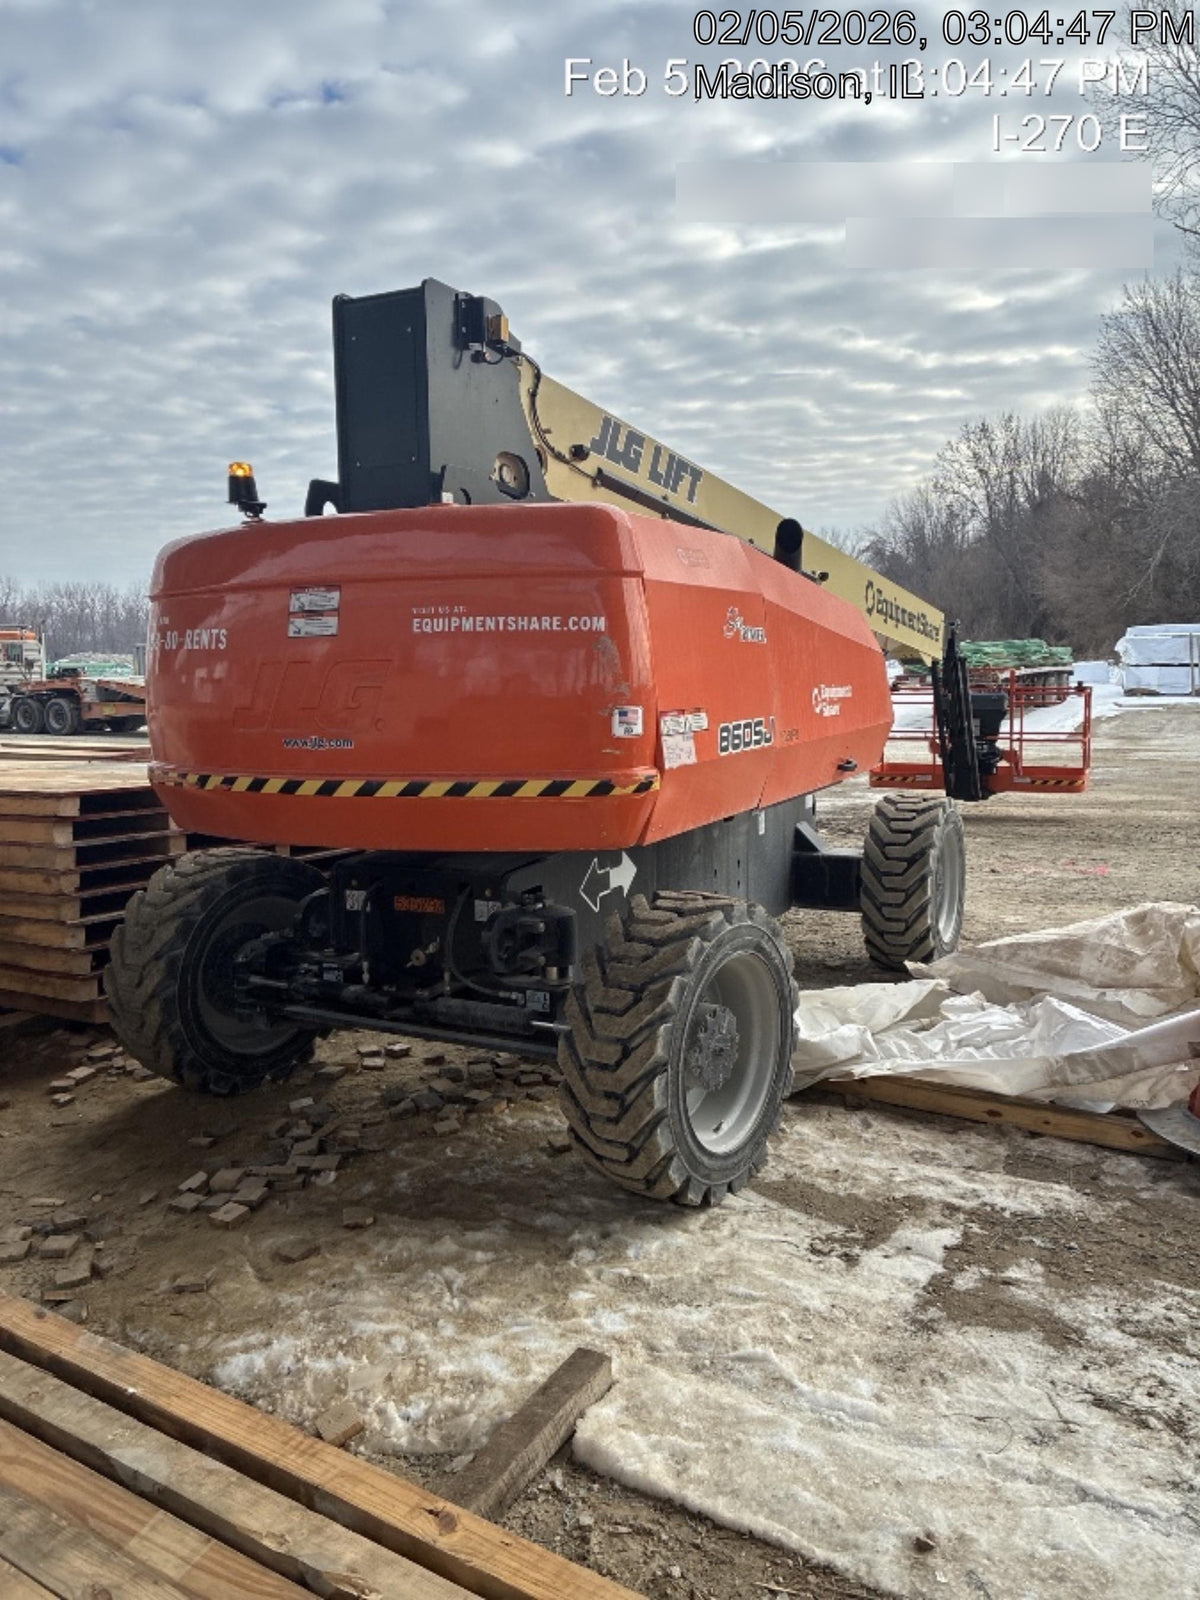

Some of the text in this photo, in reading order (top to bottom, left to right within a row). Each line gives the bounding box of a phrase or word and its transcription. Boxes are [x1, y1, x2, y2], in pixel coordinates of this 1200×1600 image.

[589, 415, 704, 504] JLG LIFT
[412, 615, 606, 634] EQUIPMENTSHARE.COM
